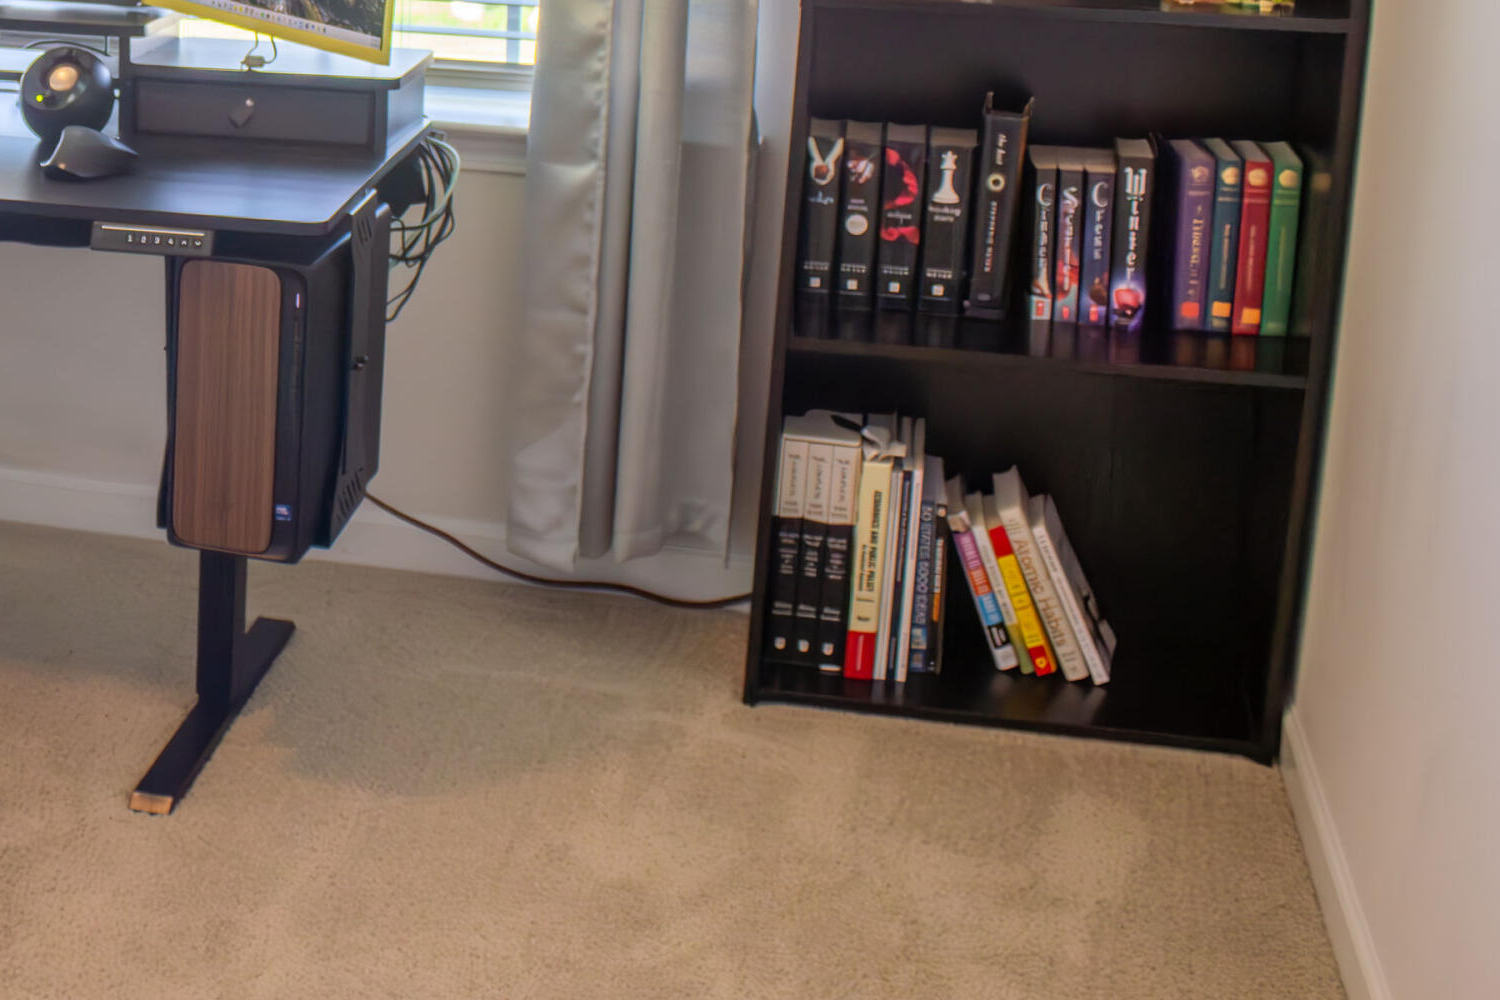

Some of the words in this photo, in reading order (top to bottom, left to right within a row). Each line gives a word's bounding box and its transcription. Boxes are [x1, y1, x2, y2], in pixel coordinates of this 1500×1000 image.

[127, 233, 133, 242] 1
[1014, 537, 1045, 597] Atomic
[1038, 597, 1068, 647] Habits
